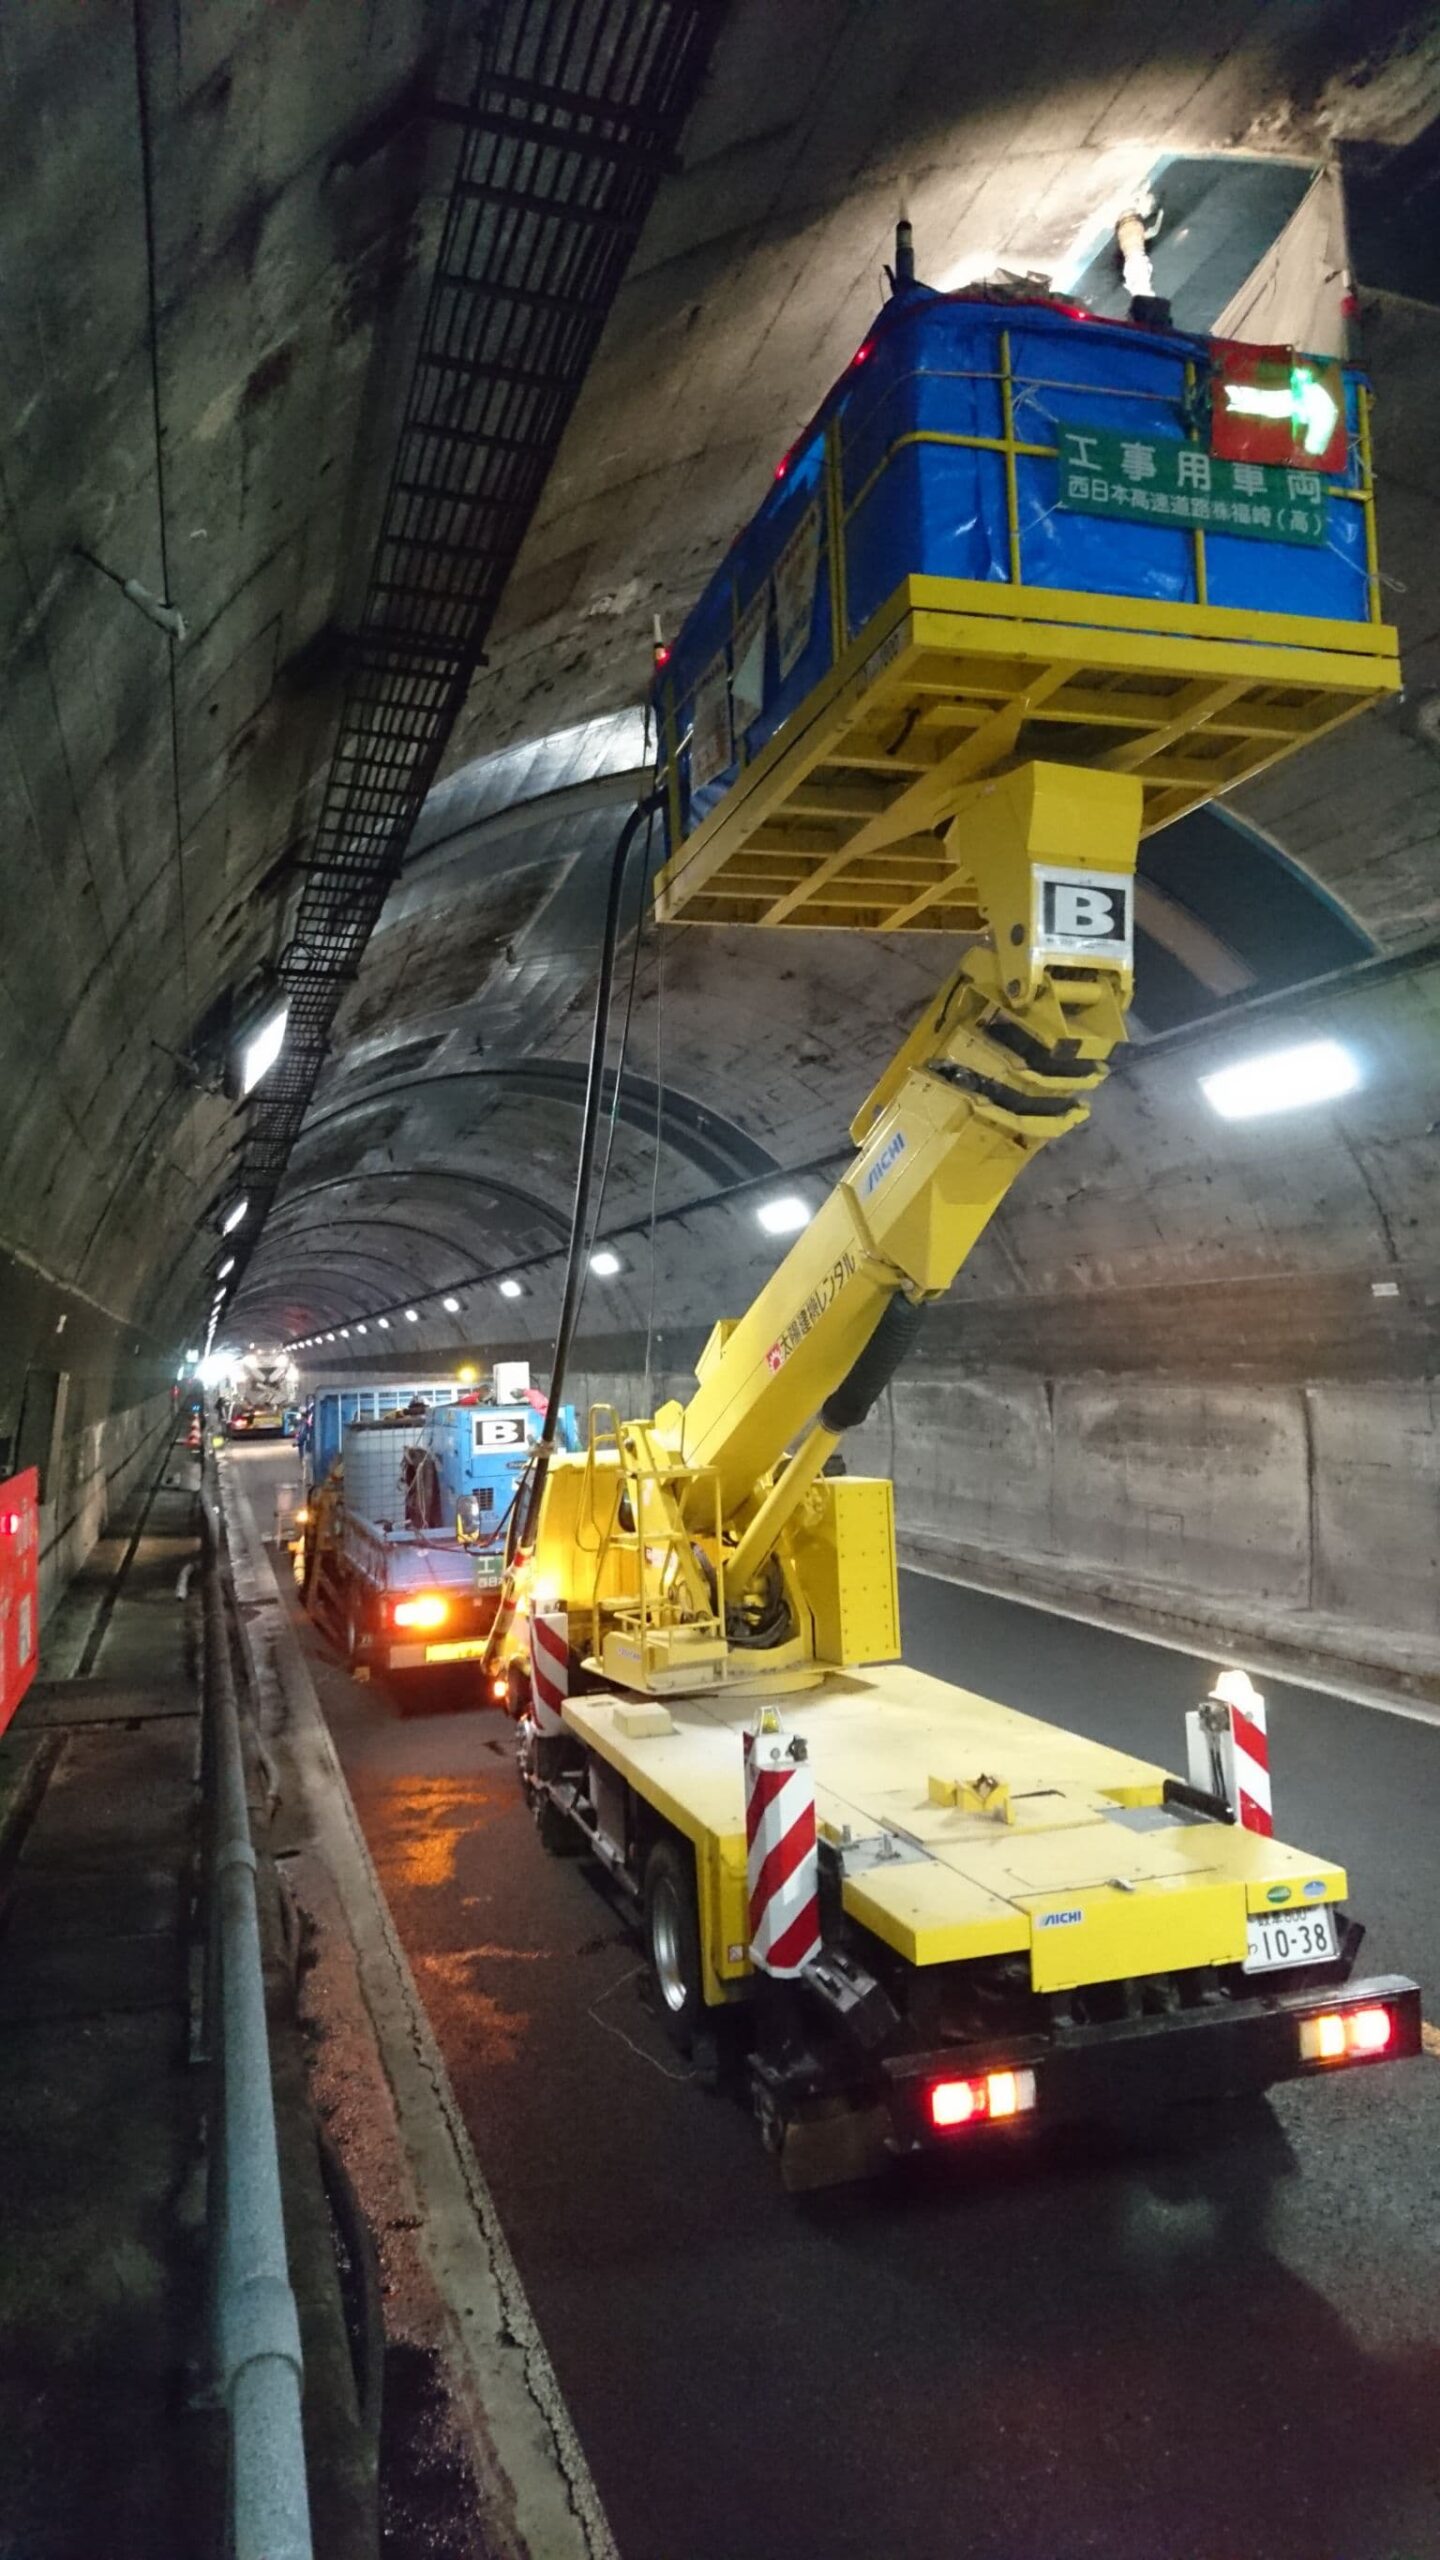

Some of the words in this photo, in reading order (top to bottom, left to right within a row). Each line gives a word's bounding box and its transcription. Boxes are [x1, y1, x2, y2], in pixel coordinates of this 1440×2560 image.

[1065, 433, 1321, 505] 工事用車両
[1052, 883, 1118, 938] B
[867, 1132, 905, 1192] AICHI
[481, 1420, 522, 1445] B
[1042, 1910, 1082, 1927] AICHI
[1263, 1922, 1328, 1960] 10-38
